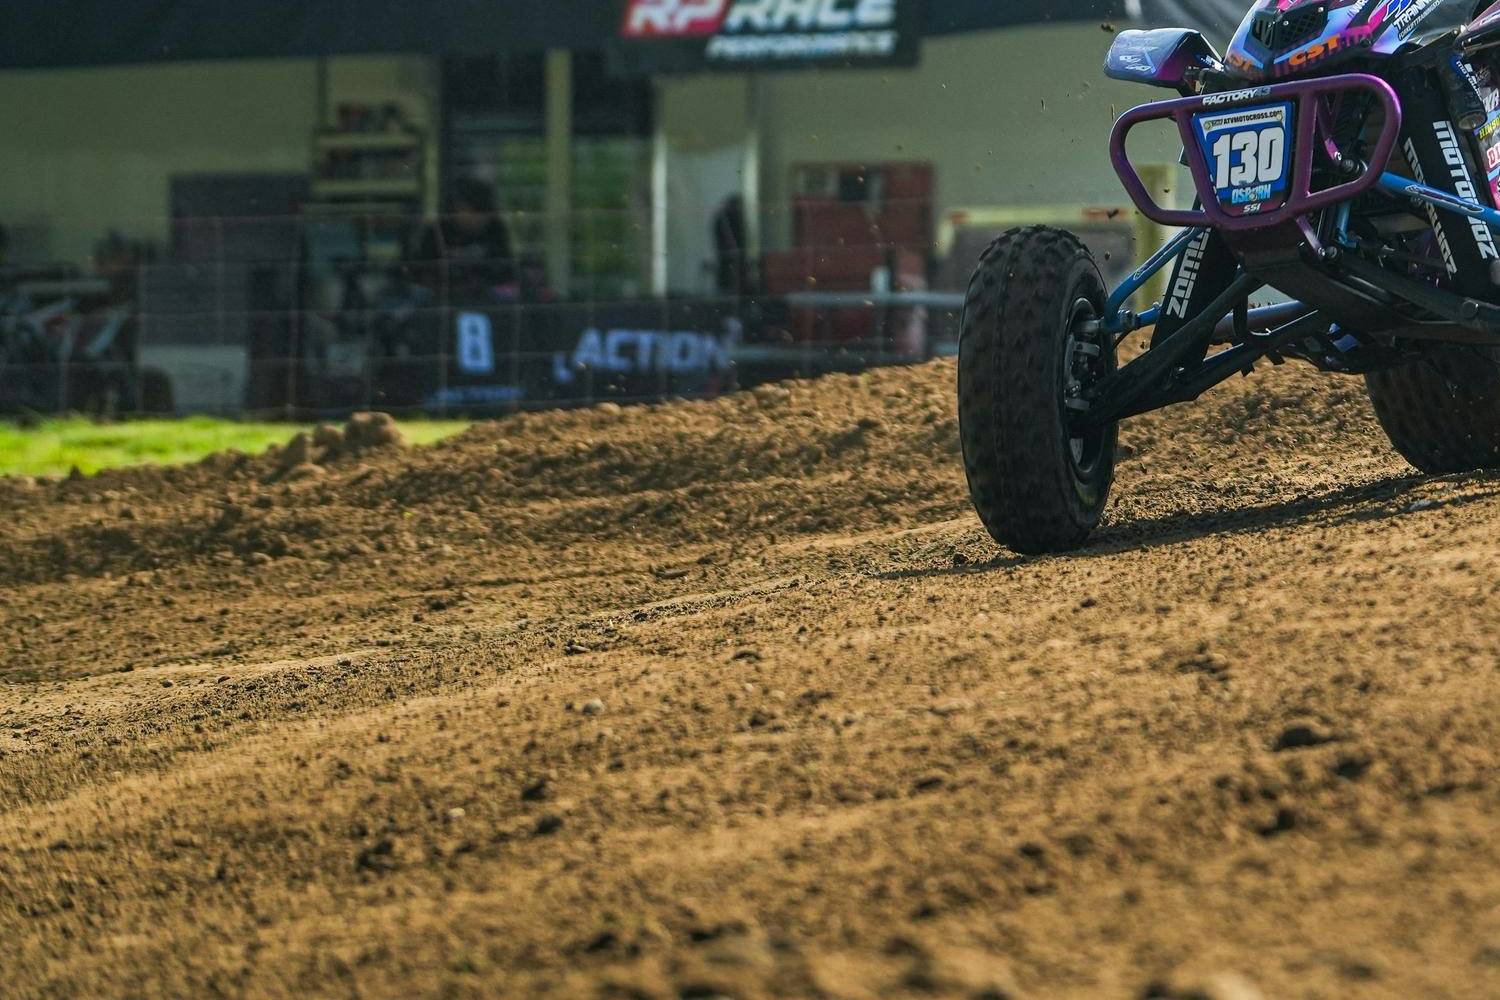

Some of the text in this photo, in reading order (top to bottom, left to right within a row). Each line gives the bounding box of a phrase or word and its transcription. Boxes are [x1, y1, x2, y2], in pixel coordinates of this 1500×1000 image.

[1288, 33, 1341, 65] CST
[1213, 126, 1285, 190] 130
[1243, 202, 1262, 214] SSI
[571, 328, 731, 373] ACTION
